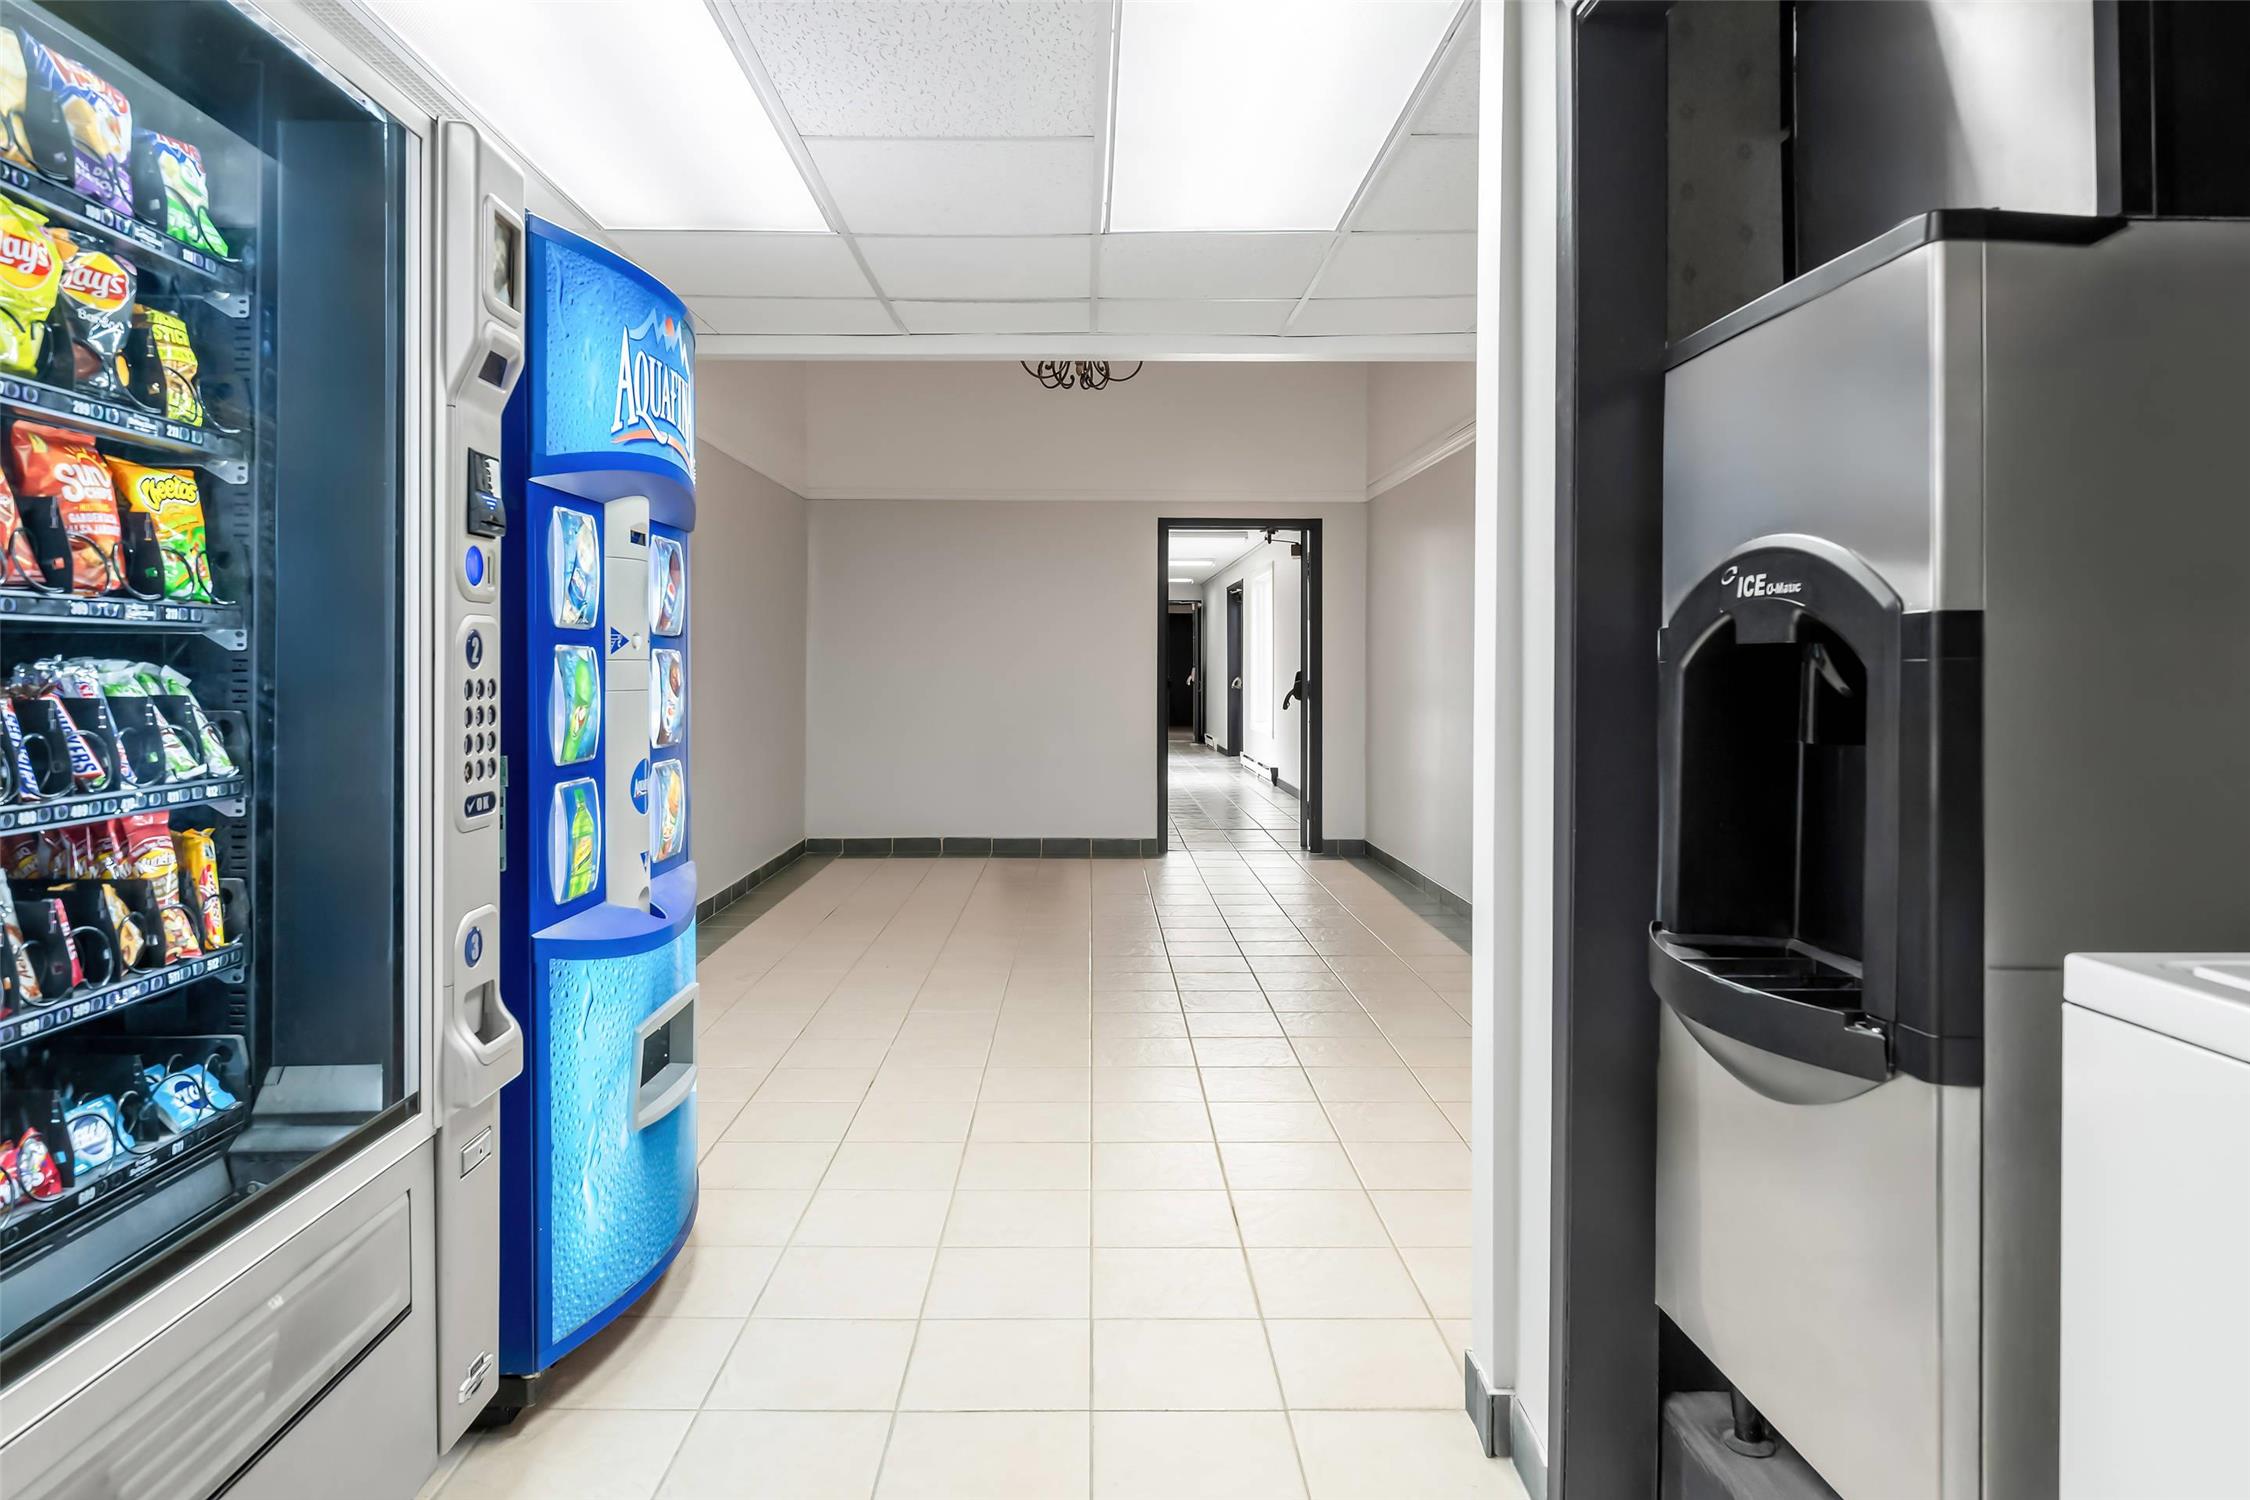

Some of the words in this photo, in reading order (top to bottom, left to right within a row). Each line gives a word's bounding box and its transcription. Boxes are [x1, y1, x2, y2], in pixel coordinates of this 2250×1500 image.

[611, 325, 691, 448] AQUAFIN
[140, 475, 198, 511] Cheetos
[1737, 573, 1767, 598] ICE
[471, 636, 480, 664] 2
[476, 795, 490, 812] OK
[471, 932, 480, 961] 3
